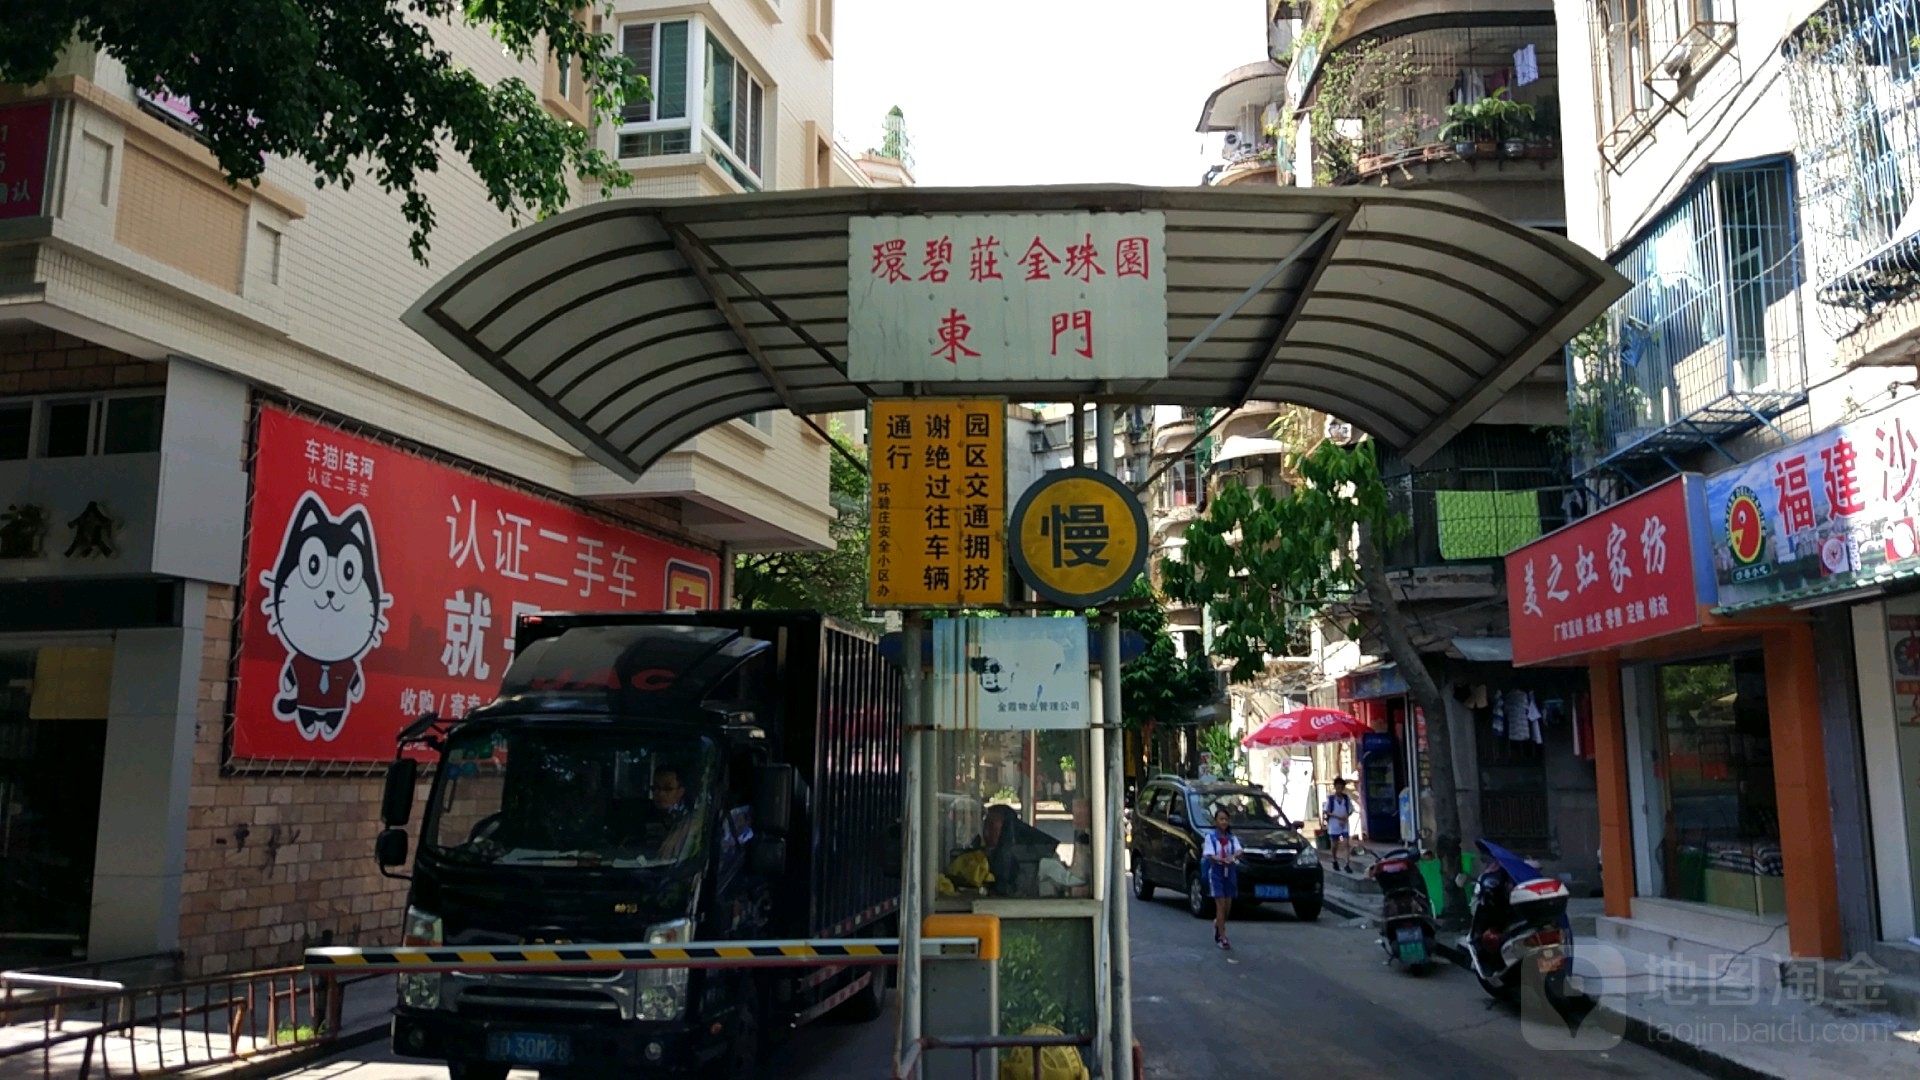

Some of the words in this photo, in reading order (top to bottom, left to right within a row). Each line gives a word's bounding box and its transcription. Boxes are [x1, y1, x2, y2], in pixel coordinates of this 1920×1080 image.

[871, 233, 1150, 285] 環碧莊金珠園
[886, 414, 912, 470] 通行
[307, 467, 369, 498] 认证二手车
[923, 414, 951, 591] 谢绝过往车辆
[963, 413, 990, 591] 园区交通拥挤
[446, 495, 637, 607] 认证二手车
[1041, 504, 1109, 569] 慢
[529, 667, 676, 691] JAC
